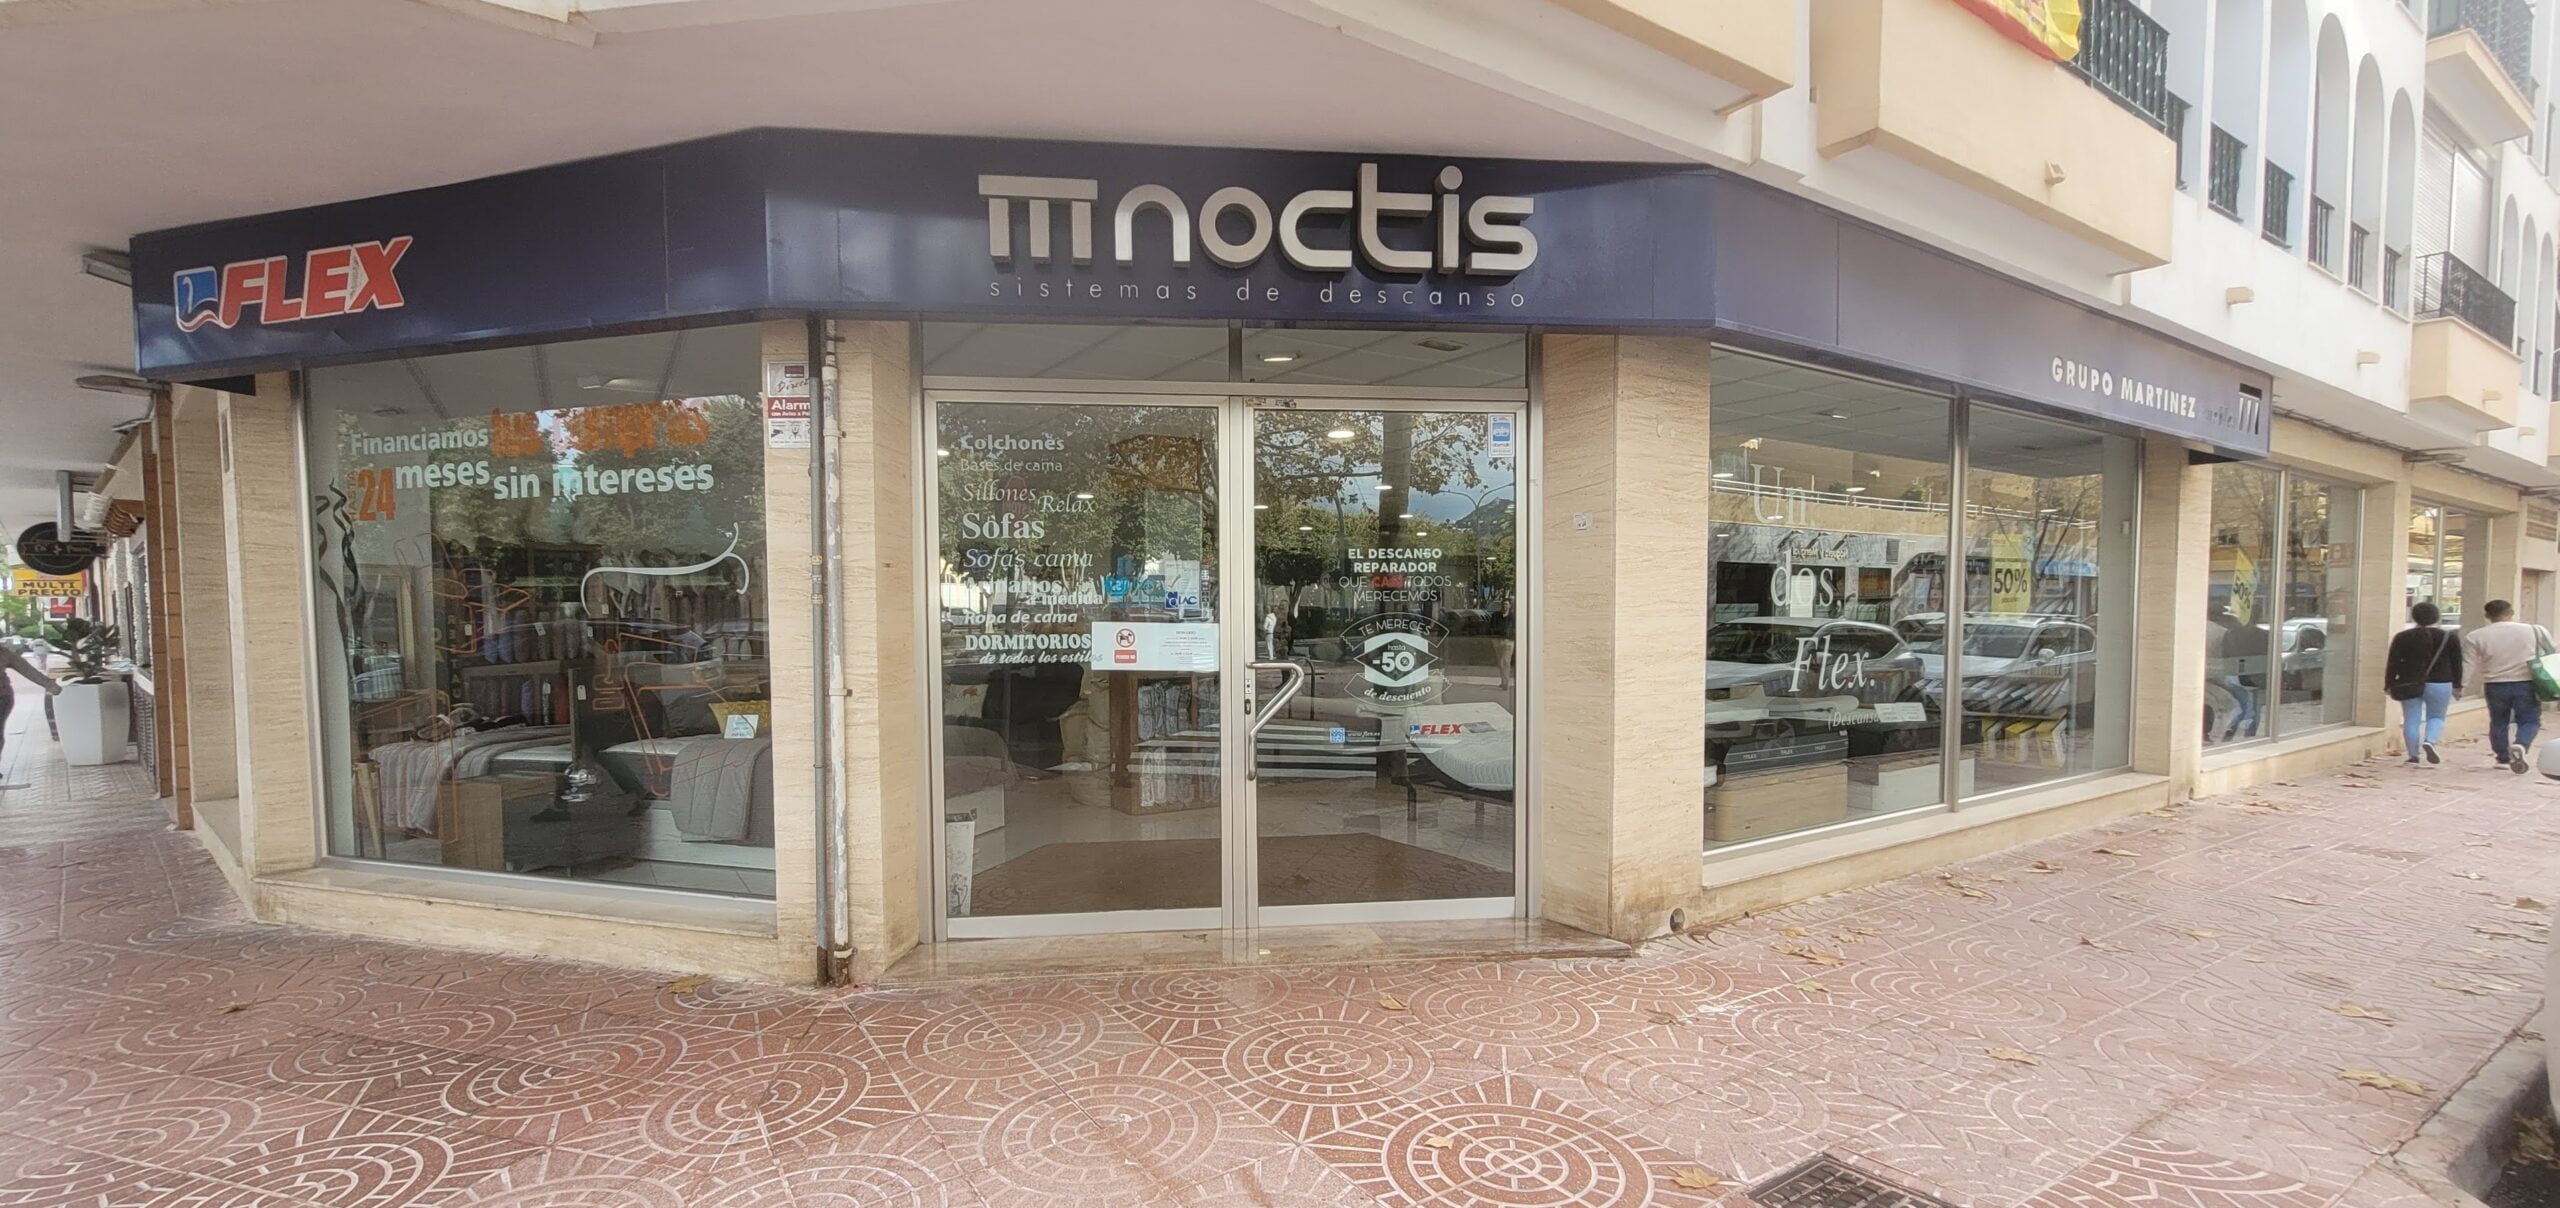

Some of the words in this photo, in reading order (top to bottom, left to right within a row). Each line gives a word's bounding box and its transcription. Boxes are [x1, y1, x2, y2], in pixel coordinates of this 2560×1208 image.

[1114, 162, 1538, 276] noctis
[220, 236, 413, 329] FLEX
[989, 277, 1197, 301] sistemas
[1236, 277, 1280, 302] de
[1319, 280, 1525, 308] descanso
[2051, 356, 2114, 397] GRUPO
[2120, 376, 2197, 419] MARTINEZ
[771, 399, 810, 411] Alarm
[351, 427, 489, 456] Financiamos
[960, 434, 1065, 450] Colchones
[960, 459, 1000, 472] Bases
[1004, 459, 1023, 472] de
[1025, 460, 1063, 472] cama
[358, 467, 396, 521] 24
[395, 461, 490, 489] meses
[493, 466, 541, 499] sin
[552, 463, 714, 498] intereses
[962, 479, 1037, 502] Sillones
[1039, 491, 1096, 513] Relax
[962, 512, 1046, 539] Sofás
[963, 547, 1026, 573] Sofás
[1033, 552, 1094, 568] cama
[1348, 549, 1363, 559] EL
[1368, 548, 1442, 559] DESCANSO
[1353, 562, 1438, 573] REPARADOR
[22, 581, 75, 589] MULTI
[1338, 575, 1368, 588] QUE
[1406, 575, 1452, 587] TODOS
[1994, 568, 2028, 594] 50%
[18, 588, 80, 597] PRECIO
[1353, 590, 1438, 602] MERECEMOS
[963, 612, 1007, 626] Ropa
[1010, 610, 1030, 624] de
[1034, 612, 1078, 624] cama
[1358, 624, 1375, 637] TE
[1376, 618, 1432, 636] MERECES
[965, 633, 1092, 651] DORMITORIOS
[979, 652, 996, 664] de
[998, 652, 1036, 664] todos
[1038, 651, 1058, 663] los
[1060, 650, 1104, 664] estilos
[1363, 687, 1378, 698] de
[1378, 685, 1432, 702] descuento
[1420, 723, 1463, 735] FLEX
